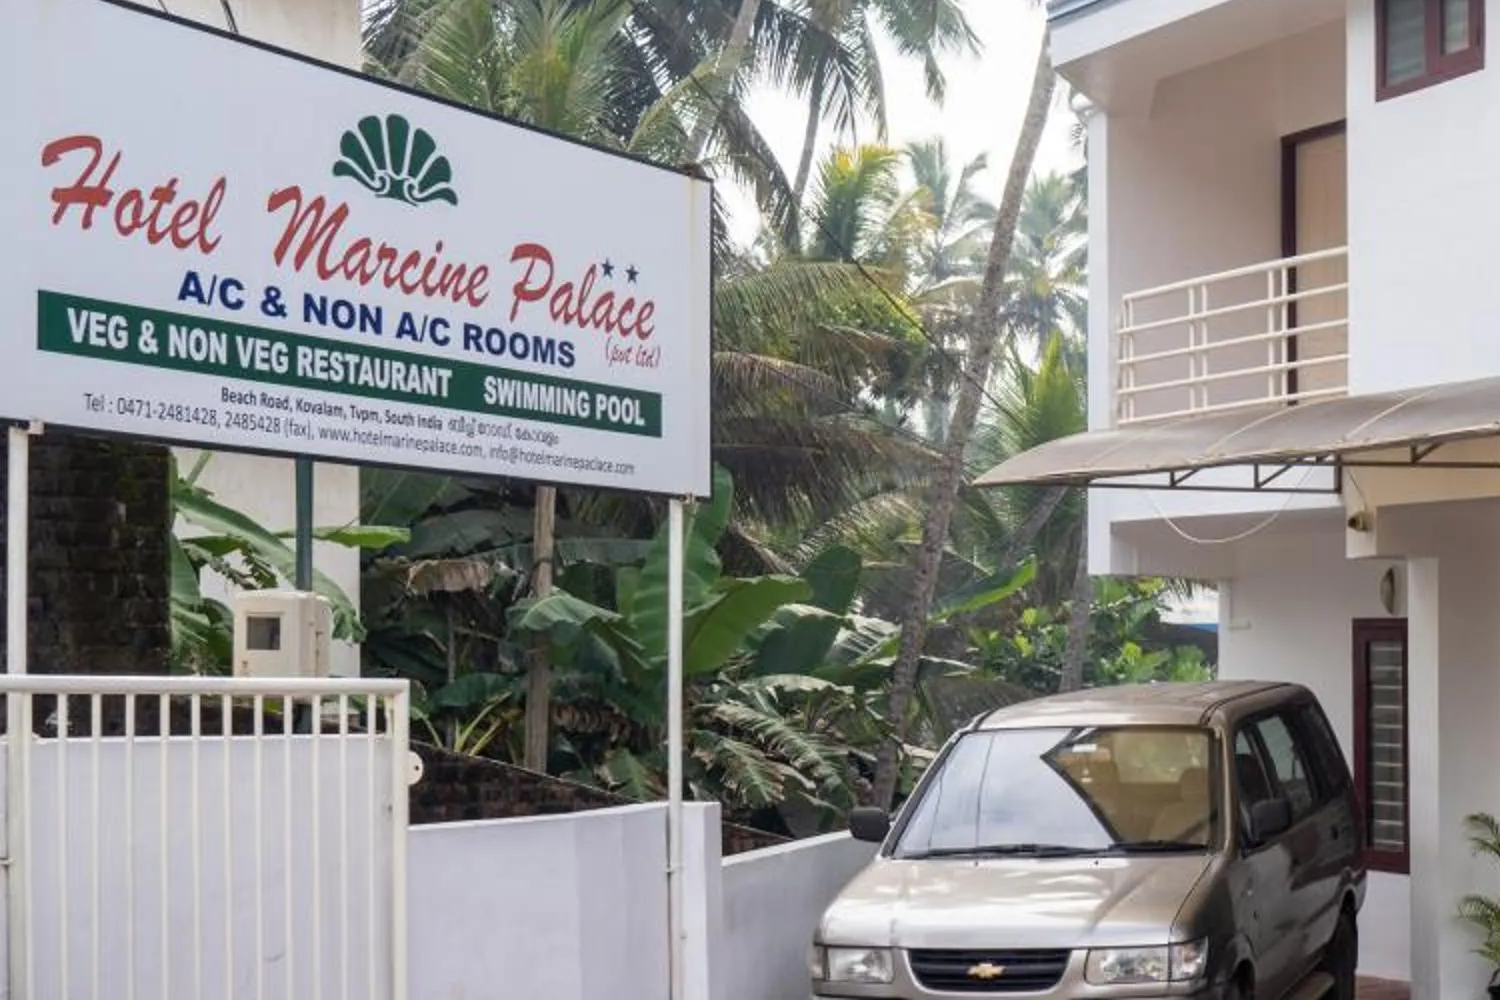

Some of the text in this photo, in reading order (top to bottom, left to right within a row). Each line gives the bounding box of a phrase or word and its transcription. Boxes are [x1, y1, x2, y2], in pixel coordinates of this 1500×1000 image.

[41, 135, 655, 341] Hotel Marcine Palace
[67, 307, 646, 426] VEG & NON VEG RESTAURANT SWIMMING POOL
[177, 270, 576, 369] A/C & NON A/C ROOMS
[221, 386, 257, 406] Beach
[259, 391, 293, 413] Road,
[296, 398, 347, 420] Kovalam,
[384, 409, 415, 427] South
[417, 414, 443, 431] India
